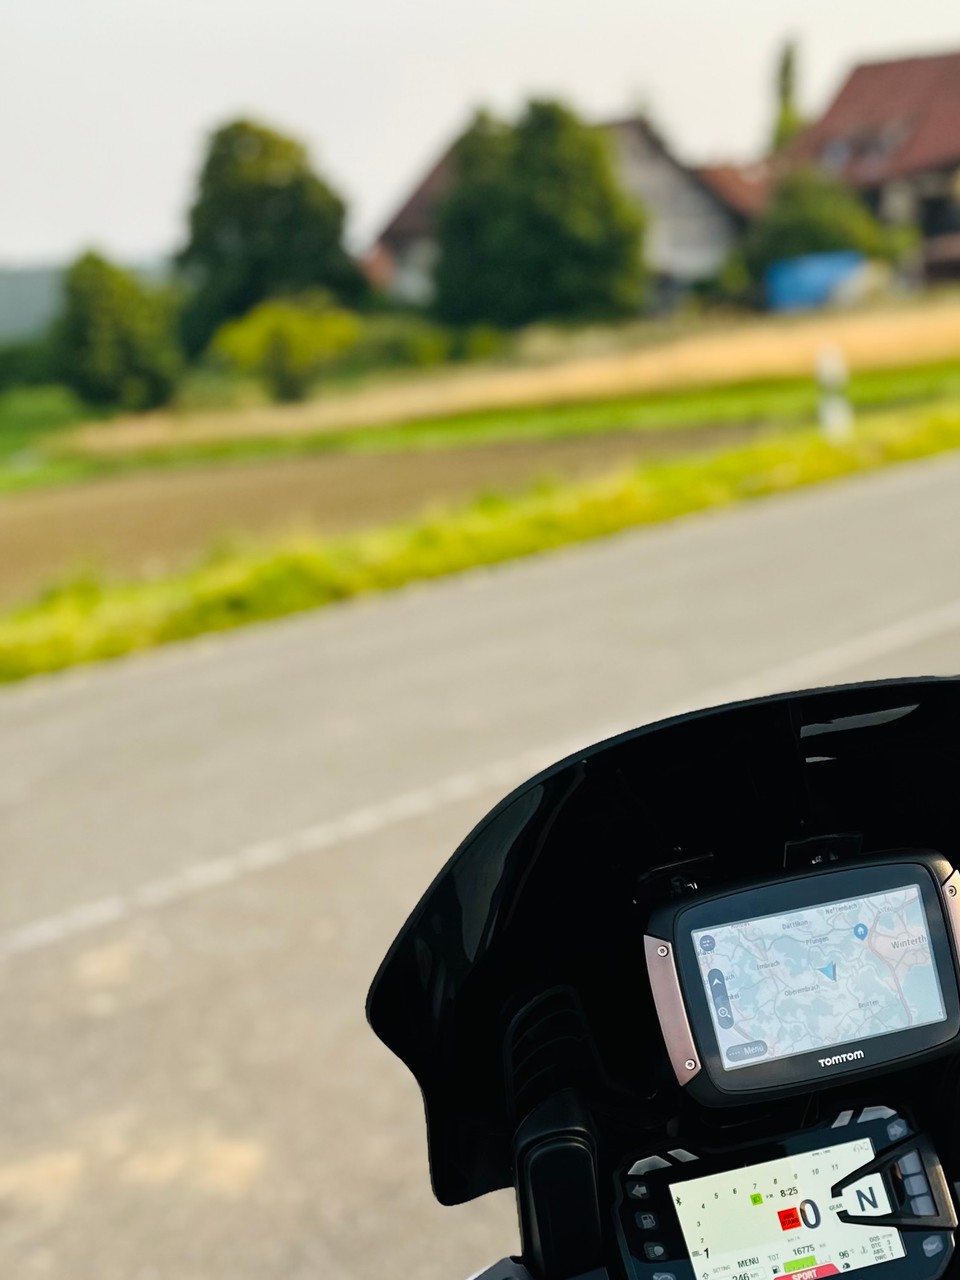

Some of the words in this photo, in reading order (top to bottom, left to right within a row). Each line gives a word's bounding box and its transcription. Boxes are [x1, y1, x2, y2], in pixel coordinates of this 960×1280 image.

[825, 903, 858, 914] Neftenbach
[805, 936, 829, 945] Pfungen
[756, 961, 781, 970] Embrach
[784, 984, 821, 996] Oberembrach
[812, 1168, 820, 1176] 10
[779, 1187, 799, 1198] 8:25
[855, 1187, 879, 1212] N
[829, 1203, 843, 1212] GEAR
[799, 1198, 821, 1229] 0
[703, 1247, 710, 1259] 1
[793, 1244, 816, 1256] 16775
[838, 1250, 850, 1260] 96
[737, 1257, 760, 1268] MENU
[768, 1253, 780, 1262] TOT
